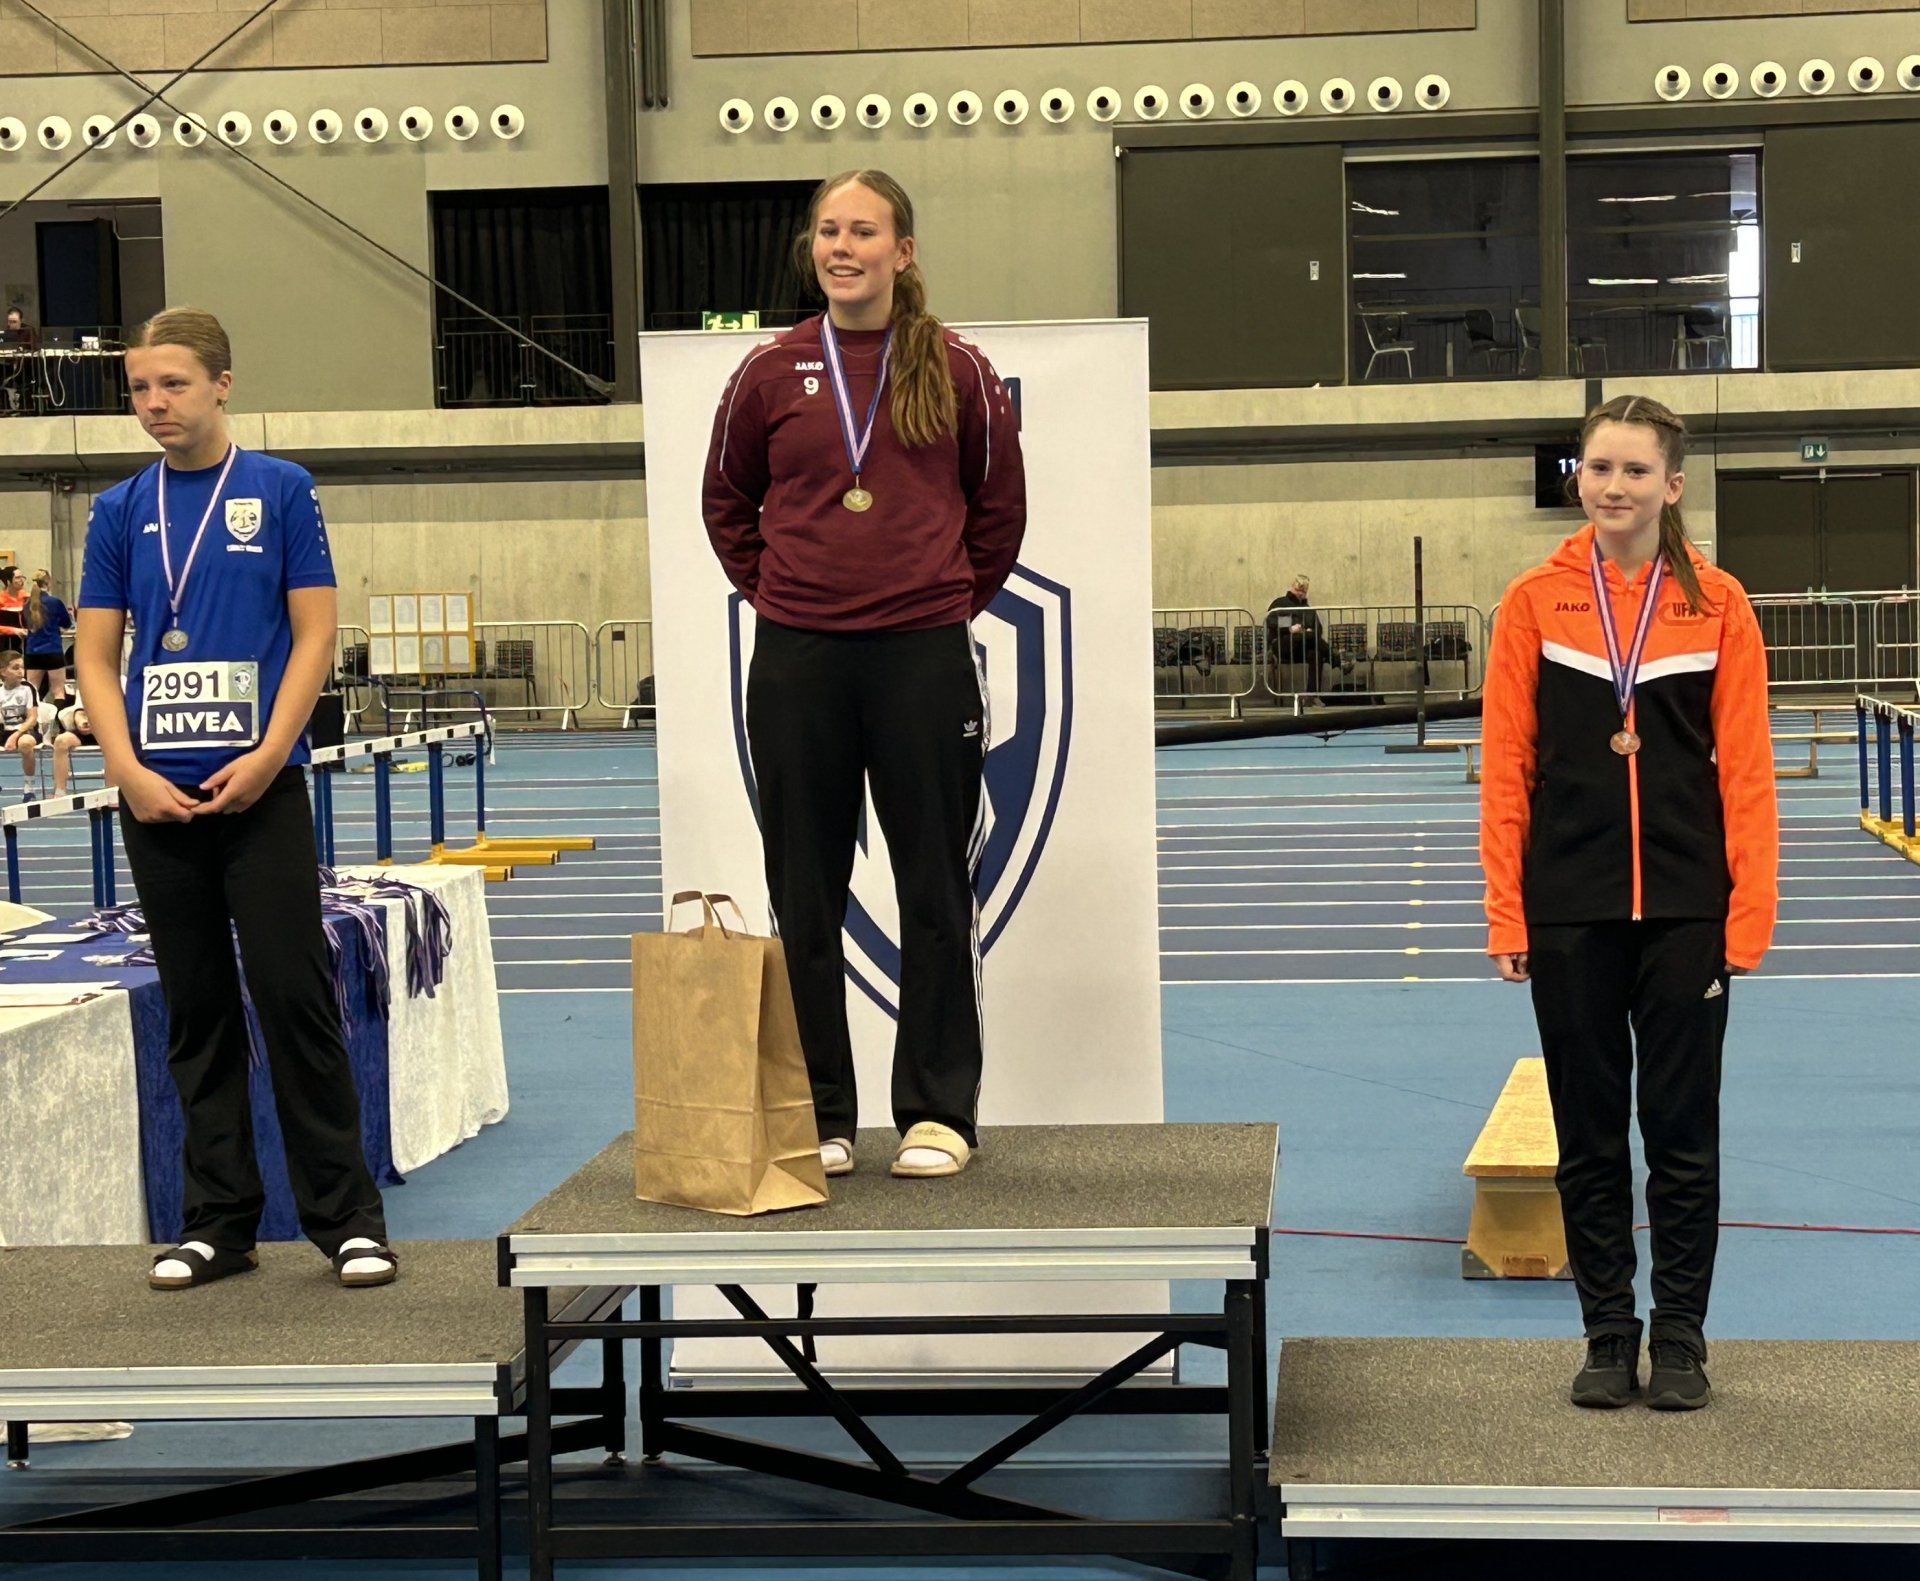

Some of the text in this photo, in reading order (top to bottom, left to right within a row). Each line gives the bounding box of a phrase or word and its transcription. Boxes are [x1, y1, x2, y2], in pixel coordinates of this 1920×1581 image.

[794, 361, 824, 371] JAKO
[803, 376, 820, 395] 9
[1554, 602, 1591, 612] JAKO
[147, 670, 219, 701] 2991
[156, 710, 245, 735] NIVEA
